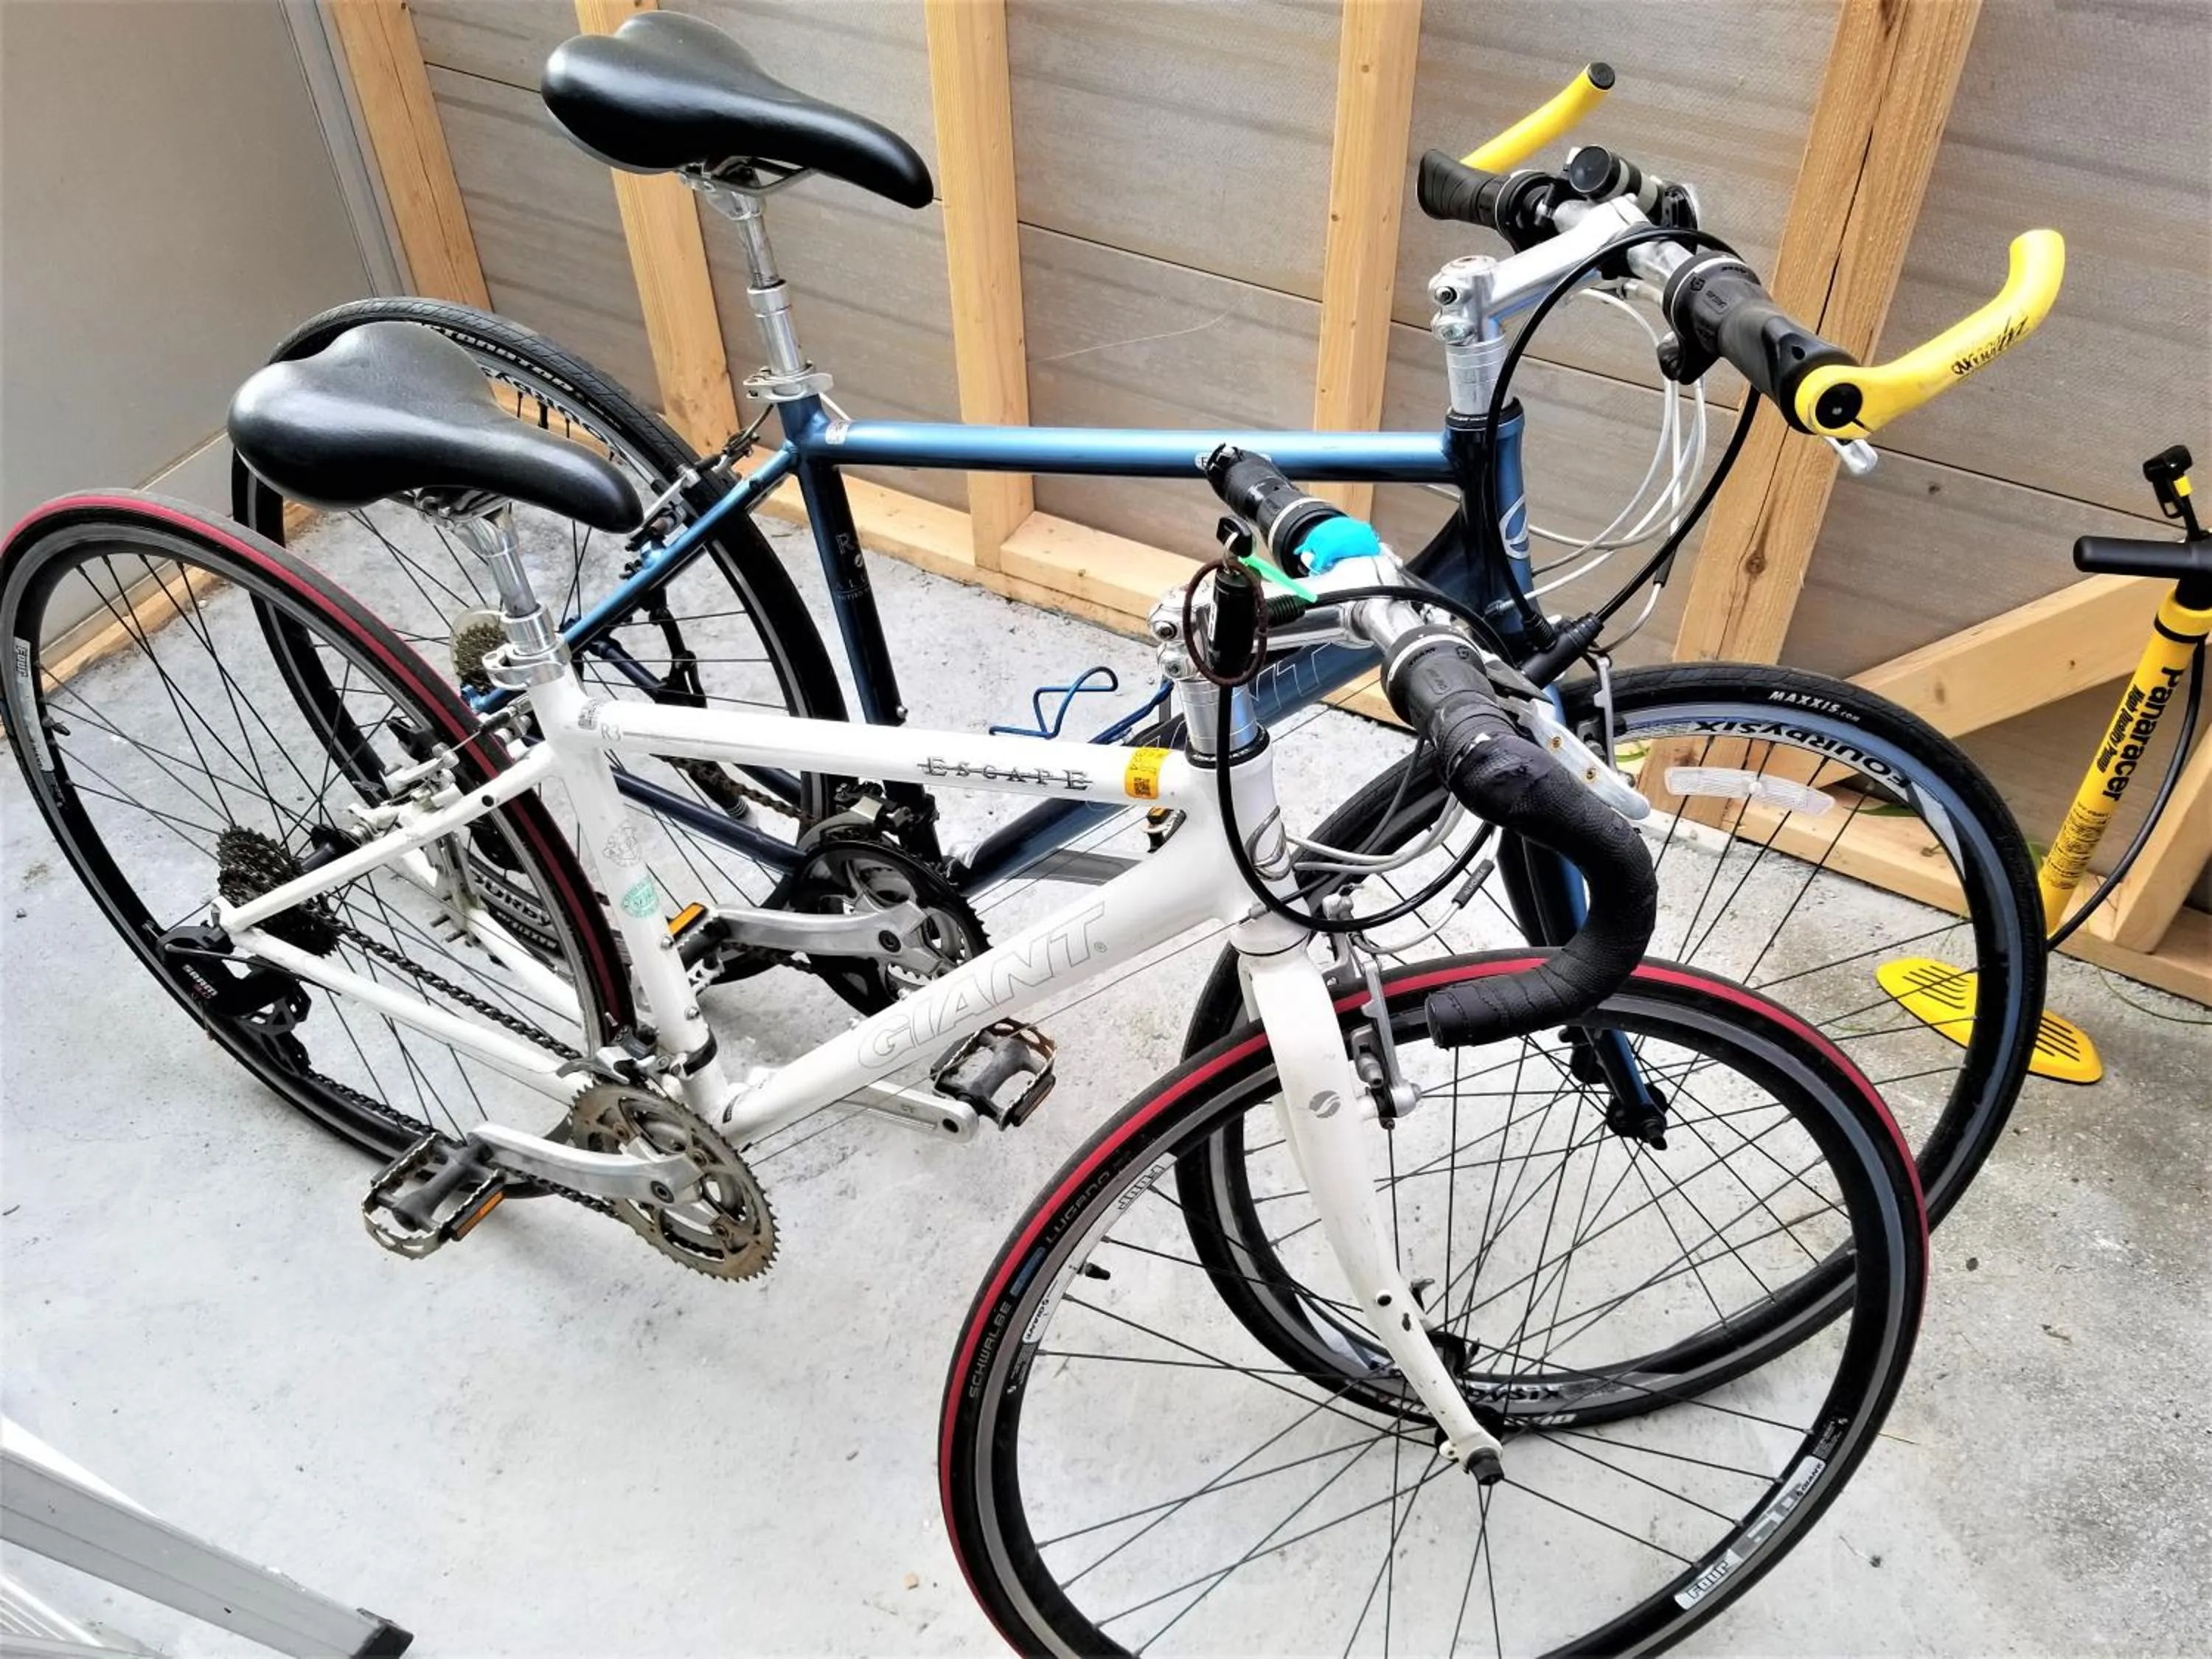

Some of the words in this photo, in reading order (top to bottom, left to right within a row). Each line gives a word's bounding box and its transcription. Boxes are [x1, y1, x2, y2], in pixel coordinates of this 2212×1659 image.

[917, 757, 1093, 790] ESCAPE
[2102, 666, 2185, 802] Panaracer
[858, 900, 1106, 1070] GIANT
[969, 1301, 1012, 1399] SCHWALBE
[1046, 1171, 1110, 1244] LUGANO
